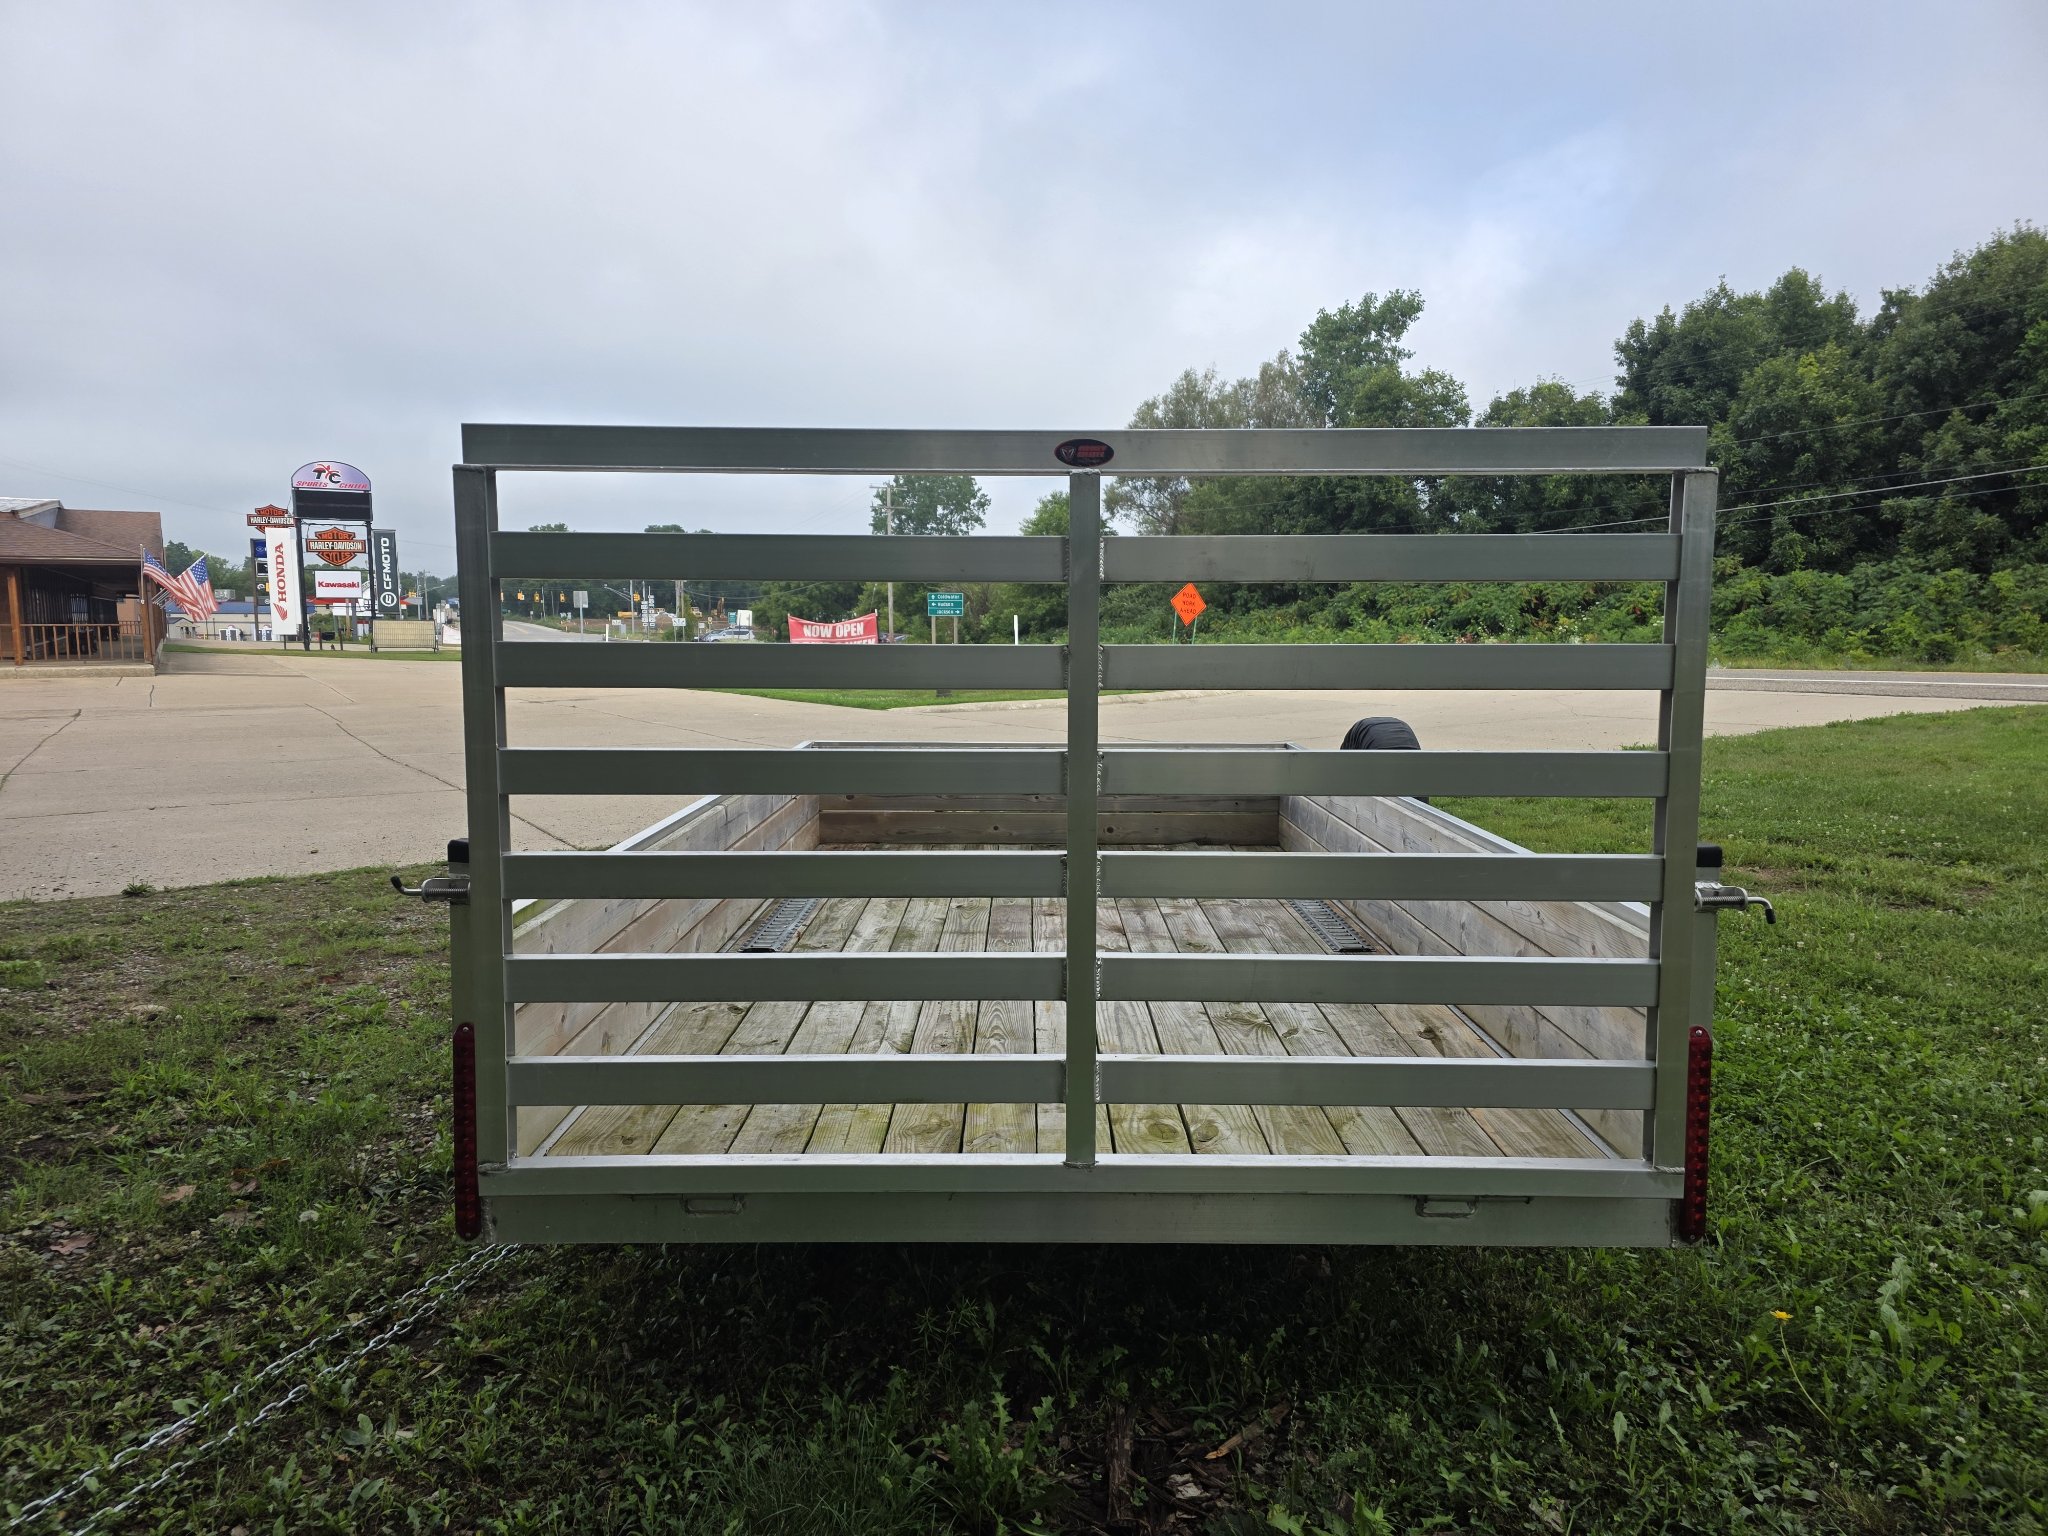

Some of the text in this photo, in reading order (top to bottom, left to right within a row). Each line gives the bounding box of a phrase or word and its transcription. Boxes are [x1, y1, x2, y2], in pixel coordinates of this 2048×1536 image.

[321, 532, 350, 540] MOTOR
[309, 541, 362, 550] HARLEY-DAVIDSON
[323, 552, 351, 563] CYCLES
[380, 536, 392, 590] CFMOTO
[274, 542, 287, 603] HONDA
[317, 581, 360, 589] Kawasaki
[1182, 592, 1197, 600] ROAD
[803, 622, 864, 638] NOW OPEN
